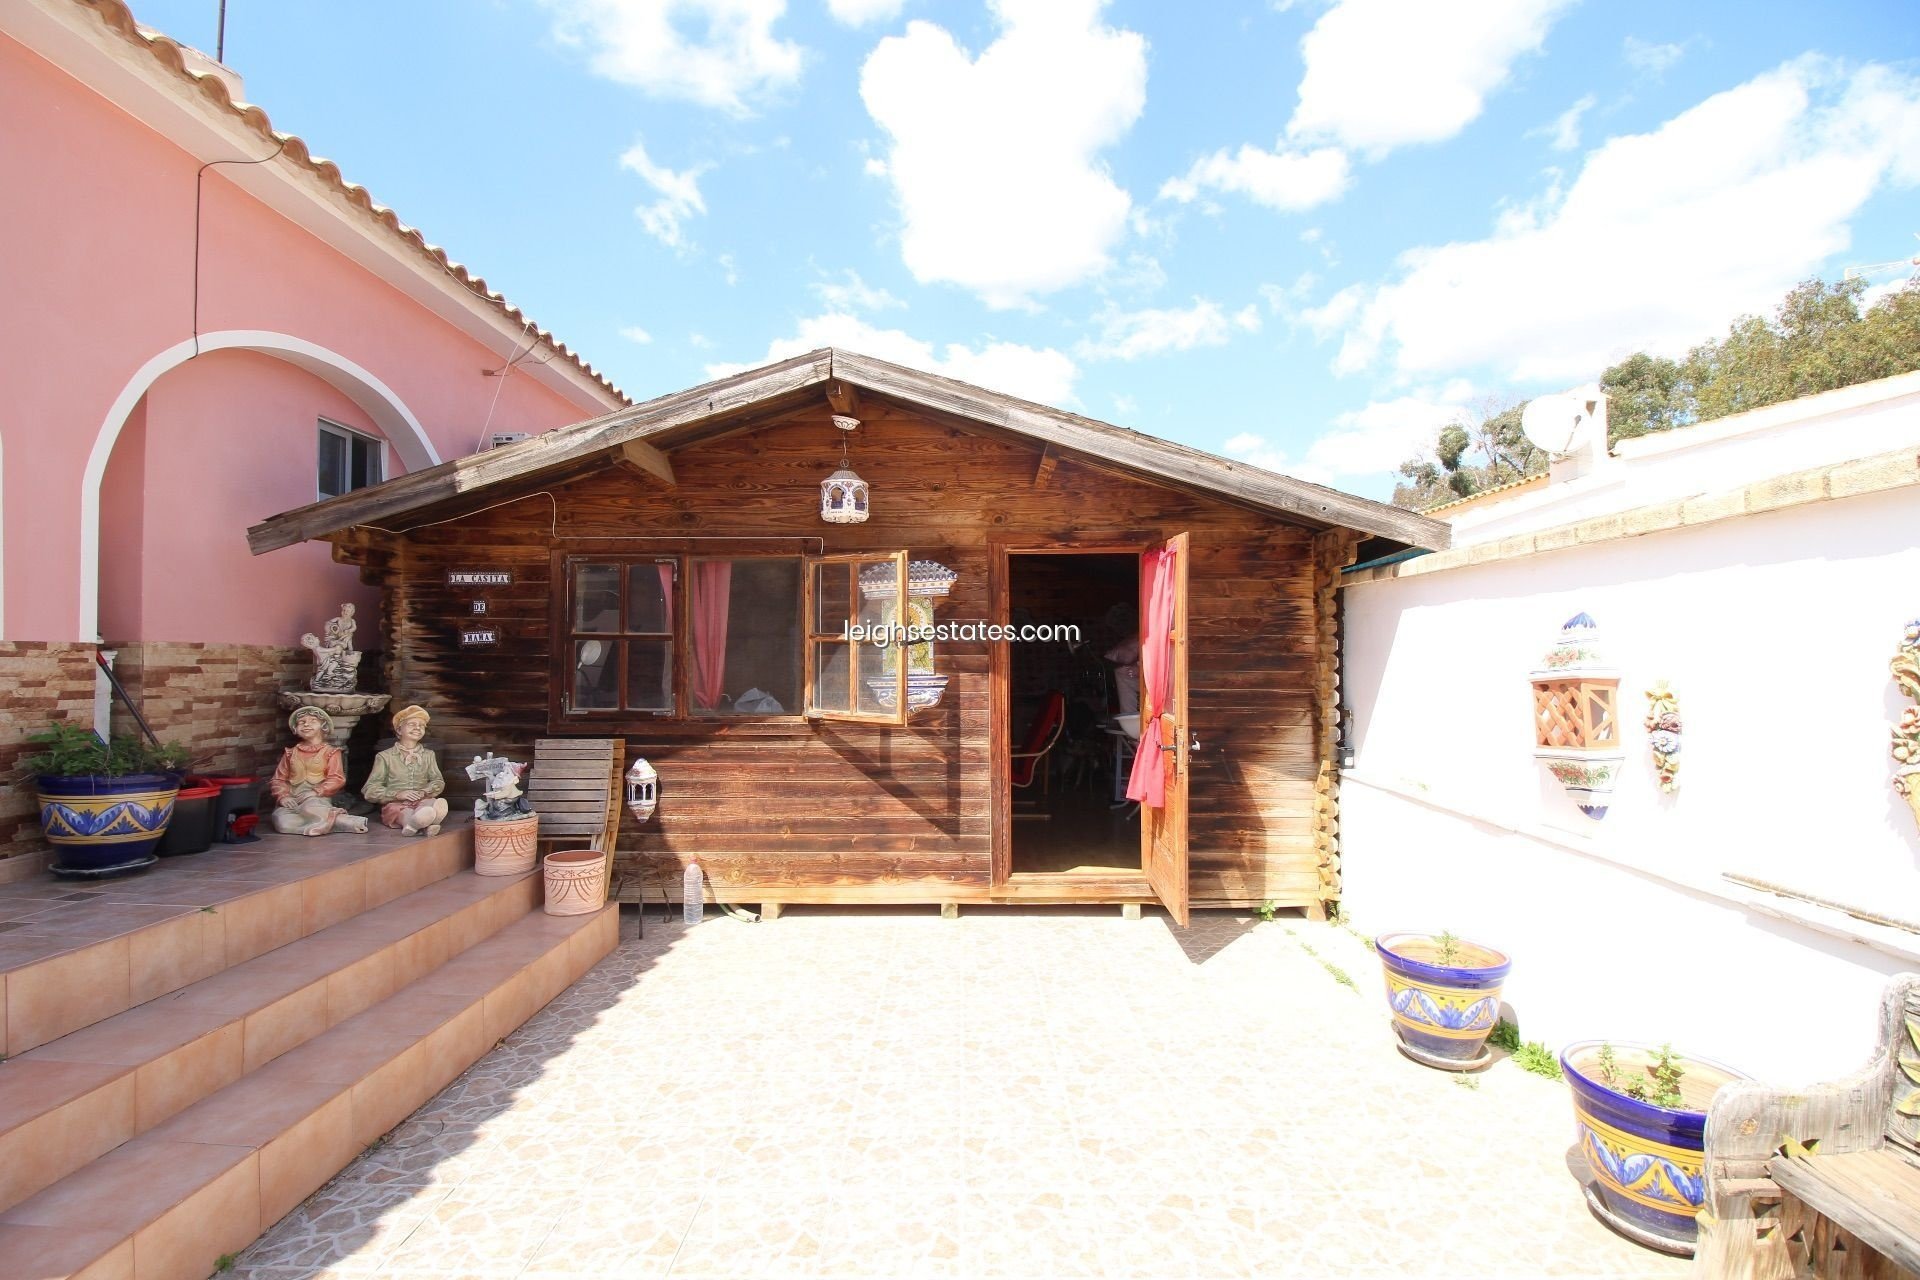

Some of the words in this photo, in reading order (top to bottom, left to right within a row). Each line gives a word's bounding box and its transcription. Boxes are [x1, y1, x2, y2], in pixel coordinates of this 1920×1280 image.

[453, 574, 466, 583] LA
[471, 574, 506, 583] CASITA
[473, 603, 485, 611] DE
[466, 633, 490, 642] MAMA
